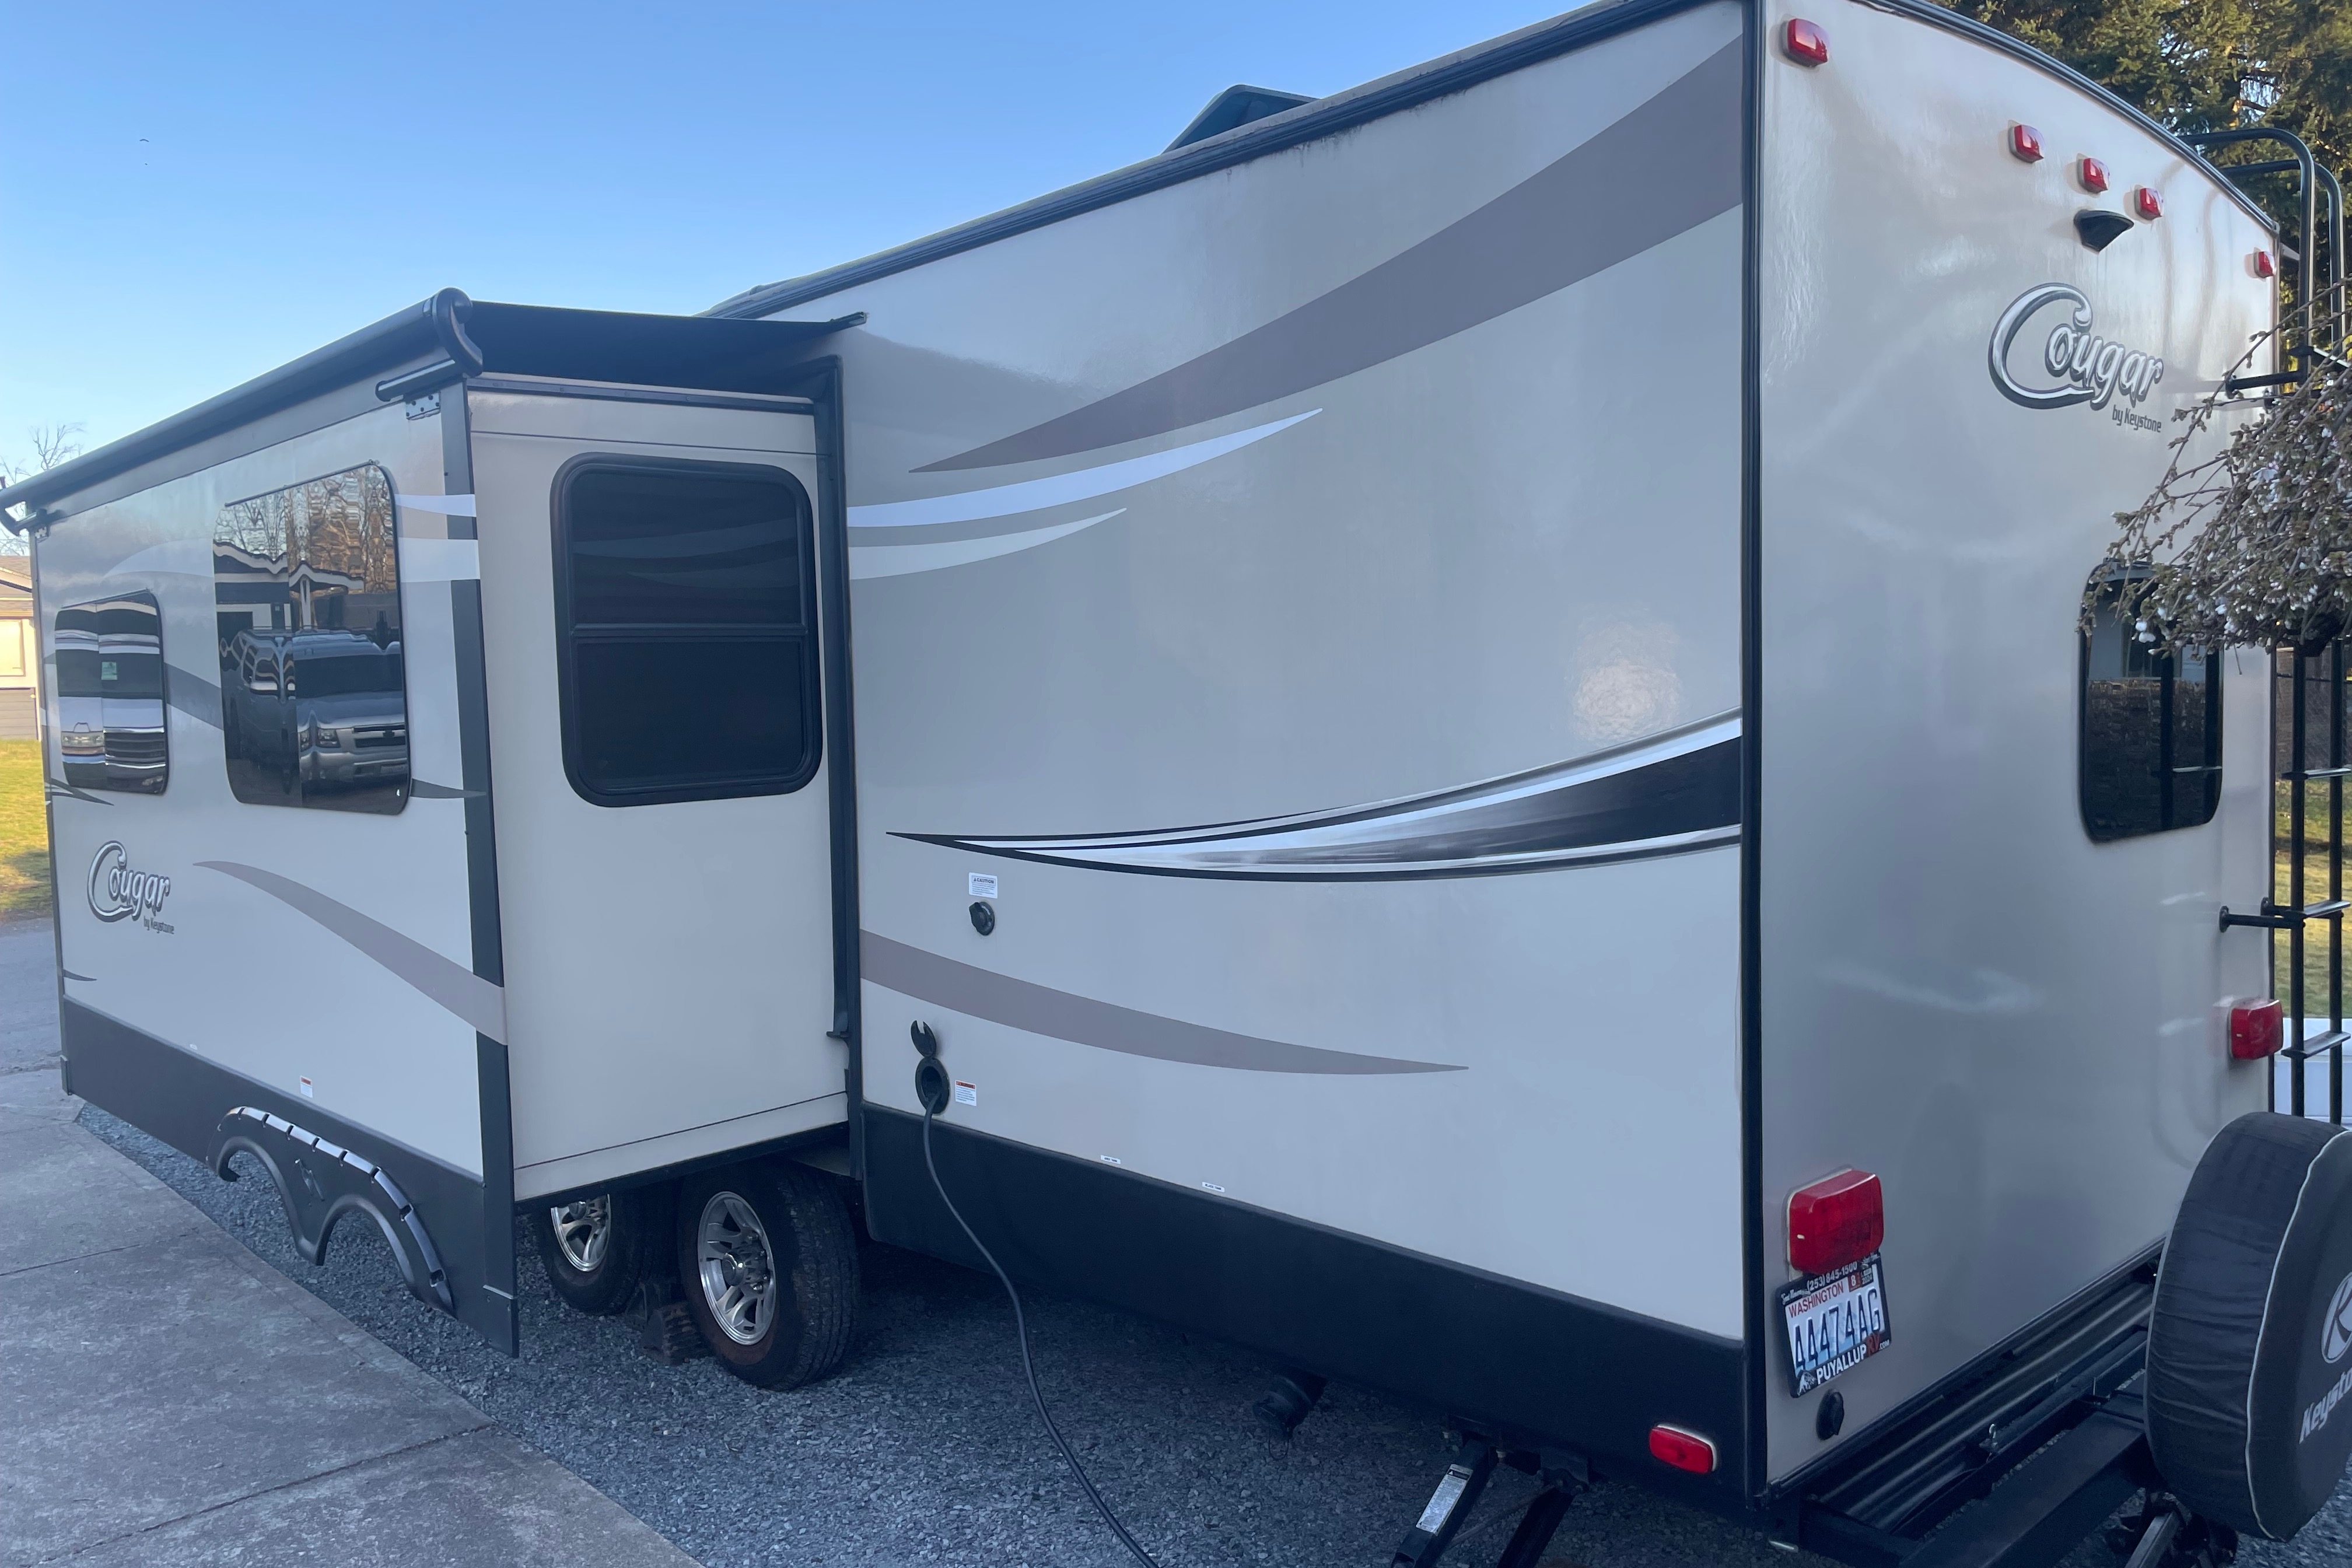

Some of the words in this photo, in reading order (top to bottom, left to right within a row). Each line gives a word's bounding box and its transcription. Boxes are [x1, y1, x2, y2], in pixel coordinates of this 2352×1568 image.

[1987, 282, 2164, 411] Cougar
[2112, 404, 2123, 426] by
[2124, 408, 2161, 433] Keystone
[87, 840, 171, 922] Cougar
[1807, 1273, 1826, 1292] (253)
[1825, 1261, 1858, 1283] 845-1500
[1851, 1275, 1856, 1287] 8
[1788, 1281, 1844, 1318] WASHINGTON
